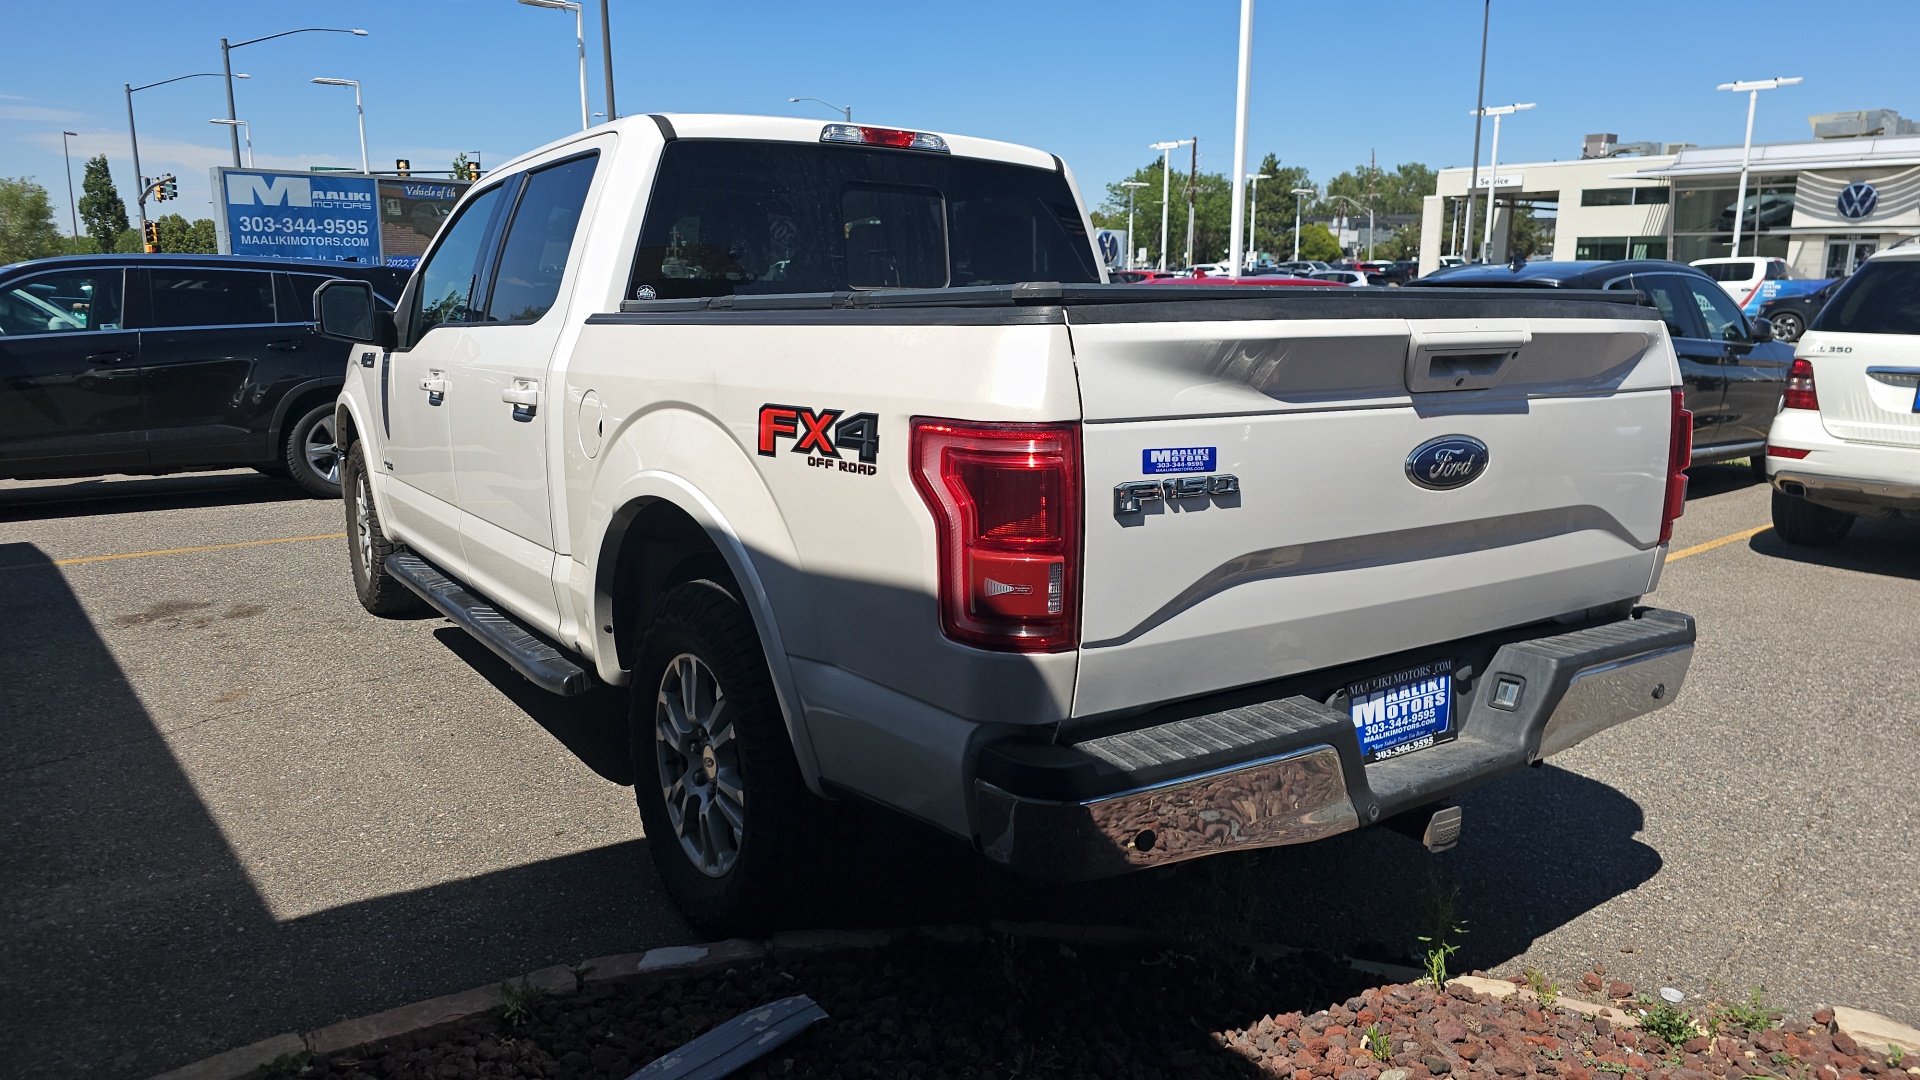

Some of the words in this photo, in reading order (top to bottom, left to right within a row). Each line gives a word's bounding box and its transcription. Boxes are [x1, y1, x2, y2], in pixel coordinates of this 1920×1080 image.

[1480, 176, 1509, 186] Sevice
[405, 184, 435, 197] Vehicle
[437, 186, 445, 199] of
[240, 216, 369, 235] 303-344-9595
[241, 235, 369, 247] MAALIKIMOTORS.COM
[1829, 346, 1853, 354] 350
[757, 402, 879, 465] FX4
[807, 456, 834, 469] OFF
[838, 461, 878, 476] ROAD
[1429, 448, 1475, 479] Ford
[1363, 718, 1436, 743] MAALIKIMOTORS.COM
[1365, 708, 1436, 736] 303-344-9595
[1374, 736, 1434, 761] 303-344-9595
